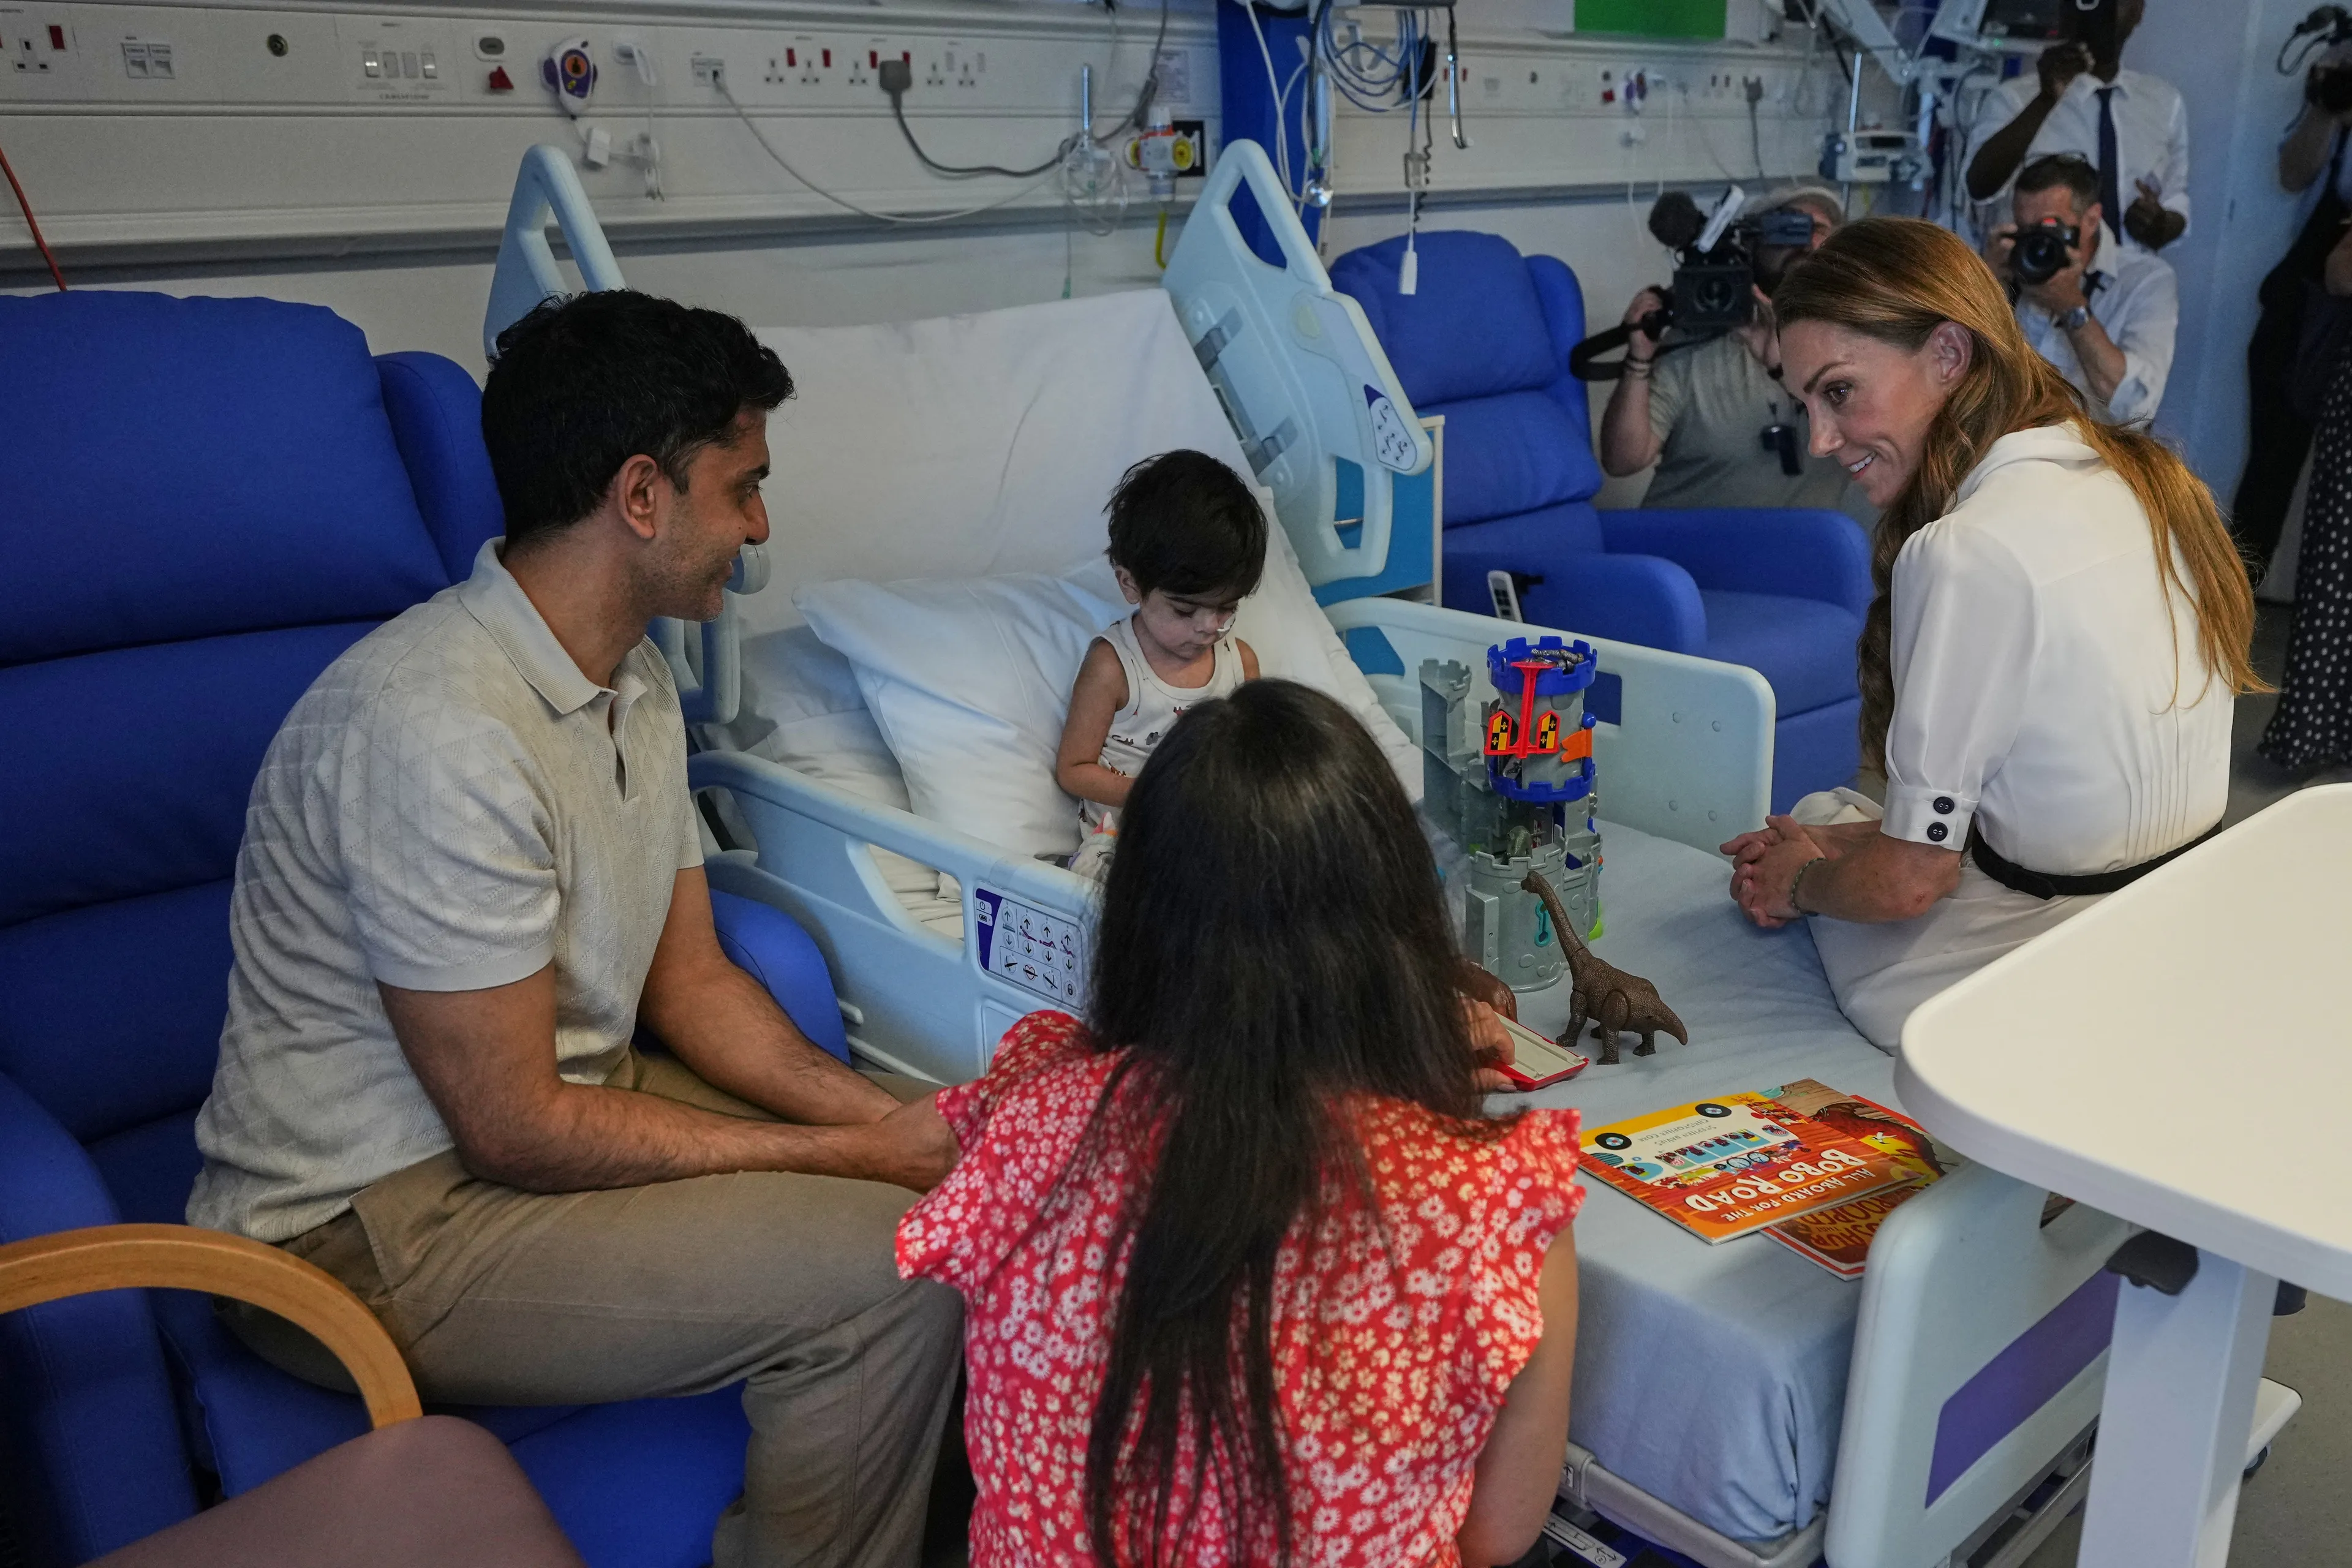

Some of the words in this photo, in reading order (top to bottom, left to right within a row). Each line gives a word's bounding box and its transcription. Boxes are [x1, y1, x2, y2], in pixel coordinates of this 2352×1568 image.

[1660, 1118, 1709, 1136] CHRISTOPHER
[1683, 1125, 1717, 1138] STEPHEN
[1777, 1148, 1868, 1183] BOBO
[1841, 1167, 1877, 1181] ALL
[1684, 1175, 1784, 1212] ROAD
[1780, 1176, 1846, 1202] ABOARD
[1749, 1199, 1782, 1212] FOR
[1720, 1208, 1755, 1221] THE
